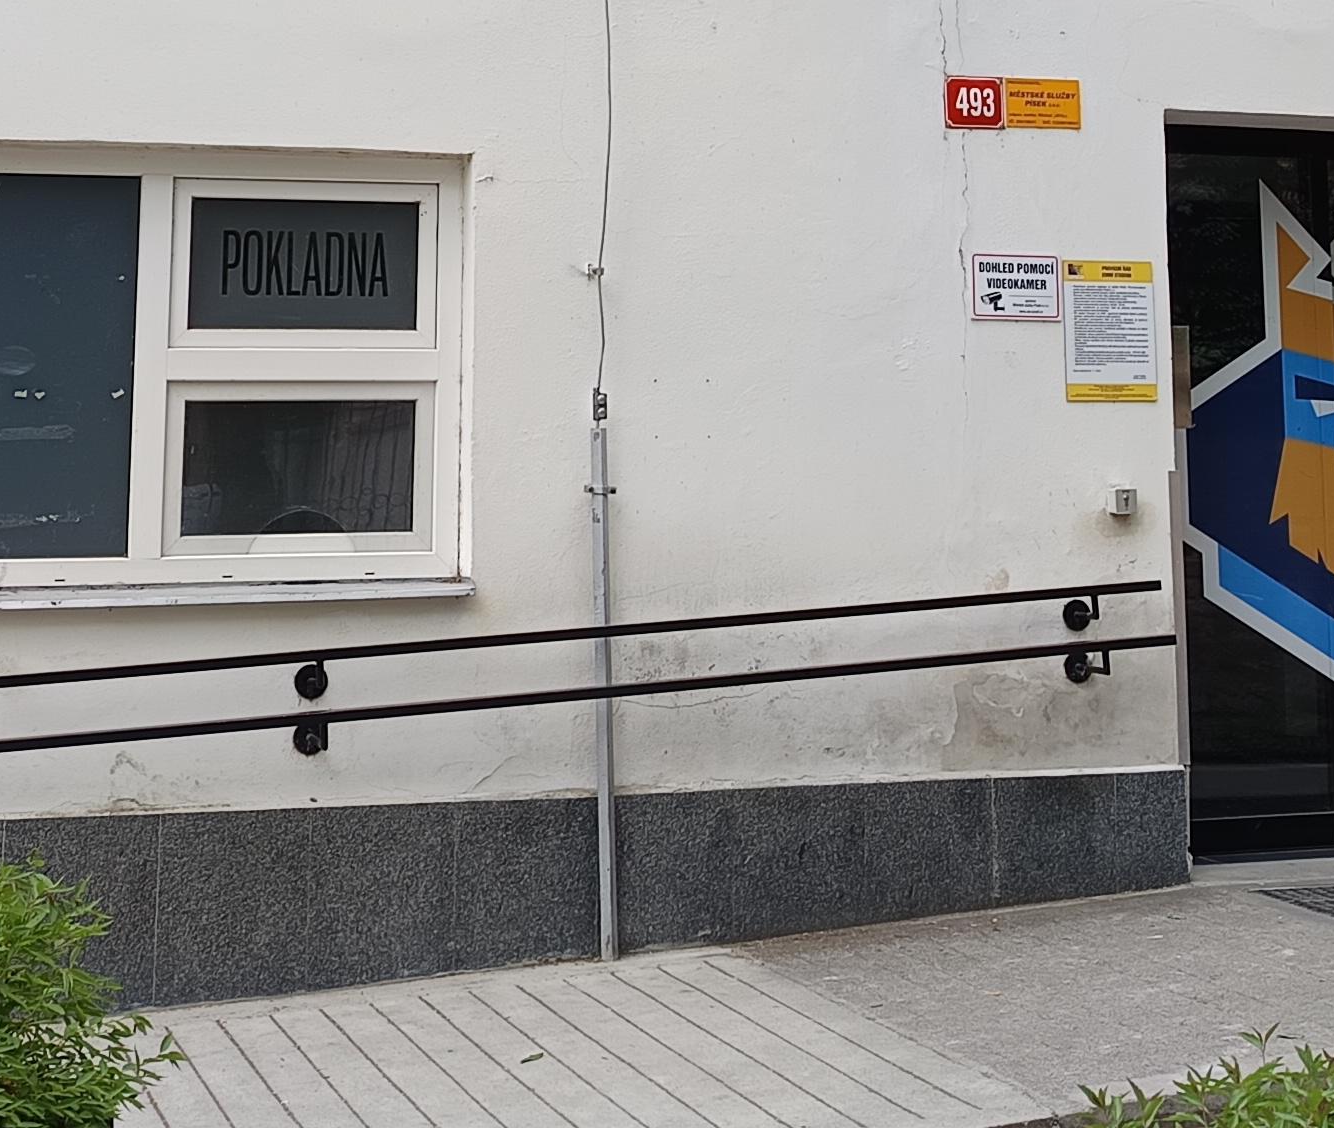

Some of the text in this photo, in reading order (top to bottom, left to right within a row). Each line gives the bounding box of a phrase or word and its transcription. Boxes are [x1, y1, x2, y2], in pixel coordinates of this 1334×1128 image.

[955, 87, 996, 118] 493
[221, 229, 389, 297] POKLADNA
[978, 261, 1054, 275] DOHLED POMOCÍ
[986, 277, 1047, 290] VIDEOKAMER
